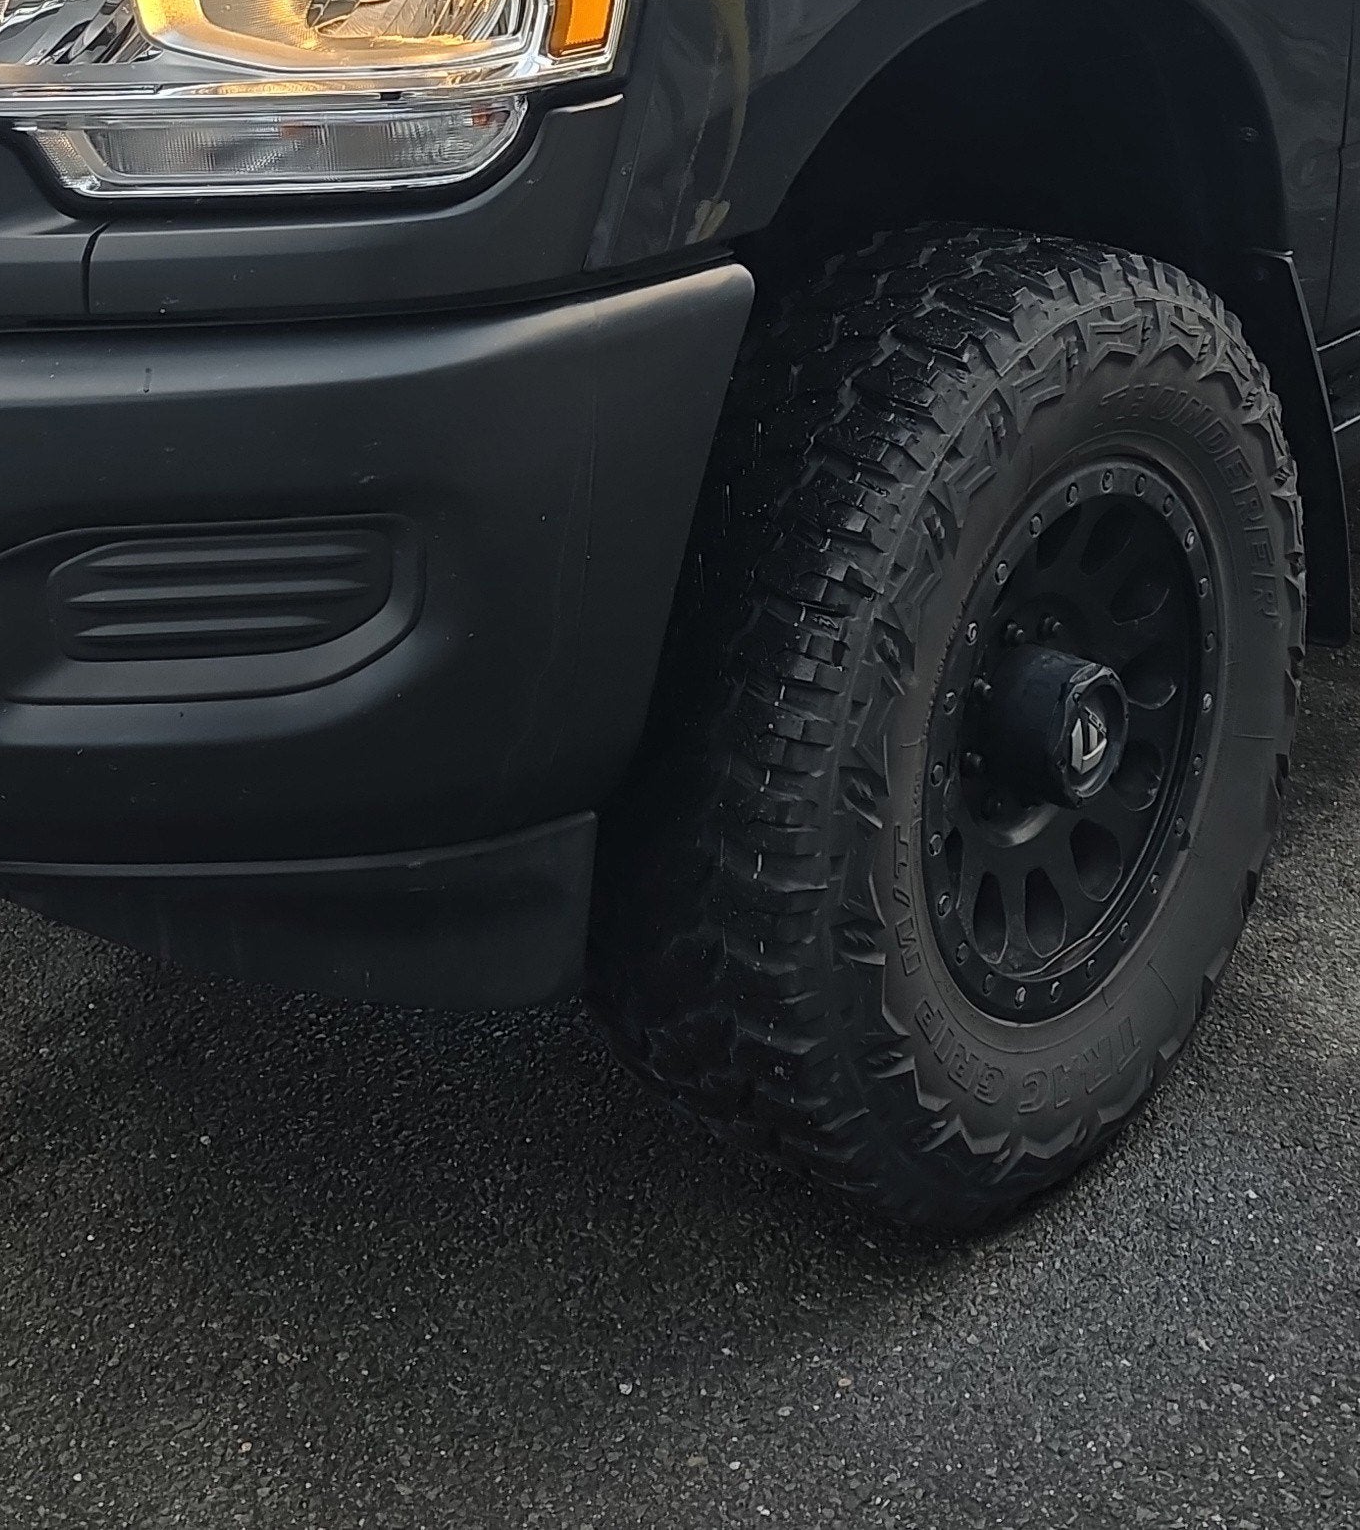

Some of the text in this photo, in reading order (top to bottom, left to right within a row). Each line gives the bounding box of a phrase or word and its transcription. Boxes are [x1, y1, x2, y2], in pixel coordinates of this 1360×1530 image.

[1092, 381, 1281, 621] THUNDERER
[892, 824, 1144, 1114] TRAC GRIP M/T
